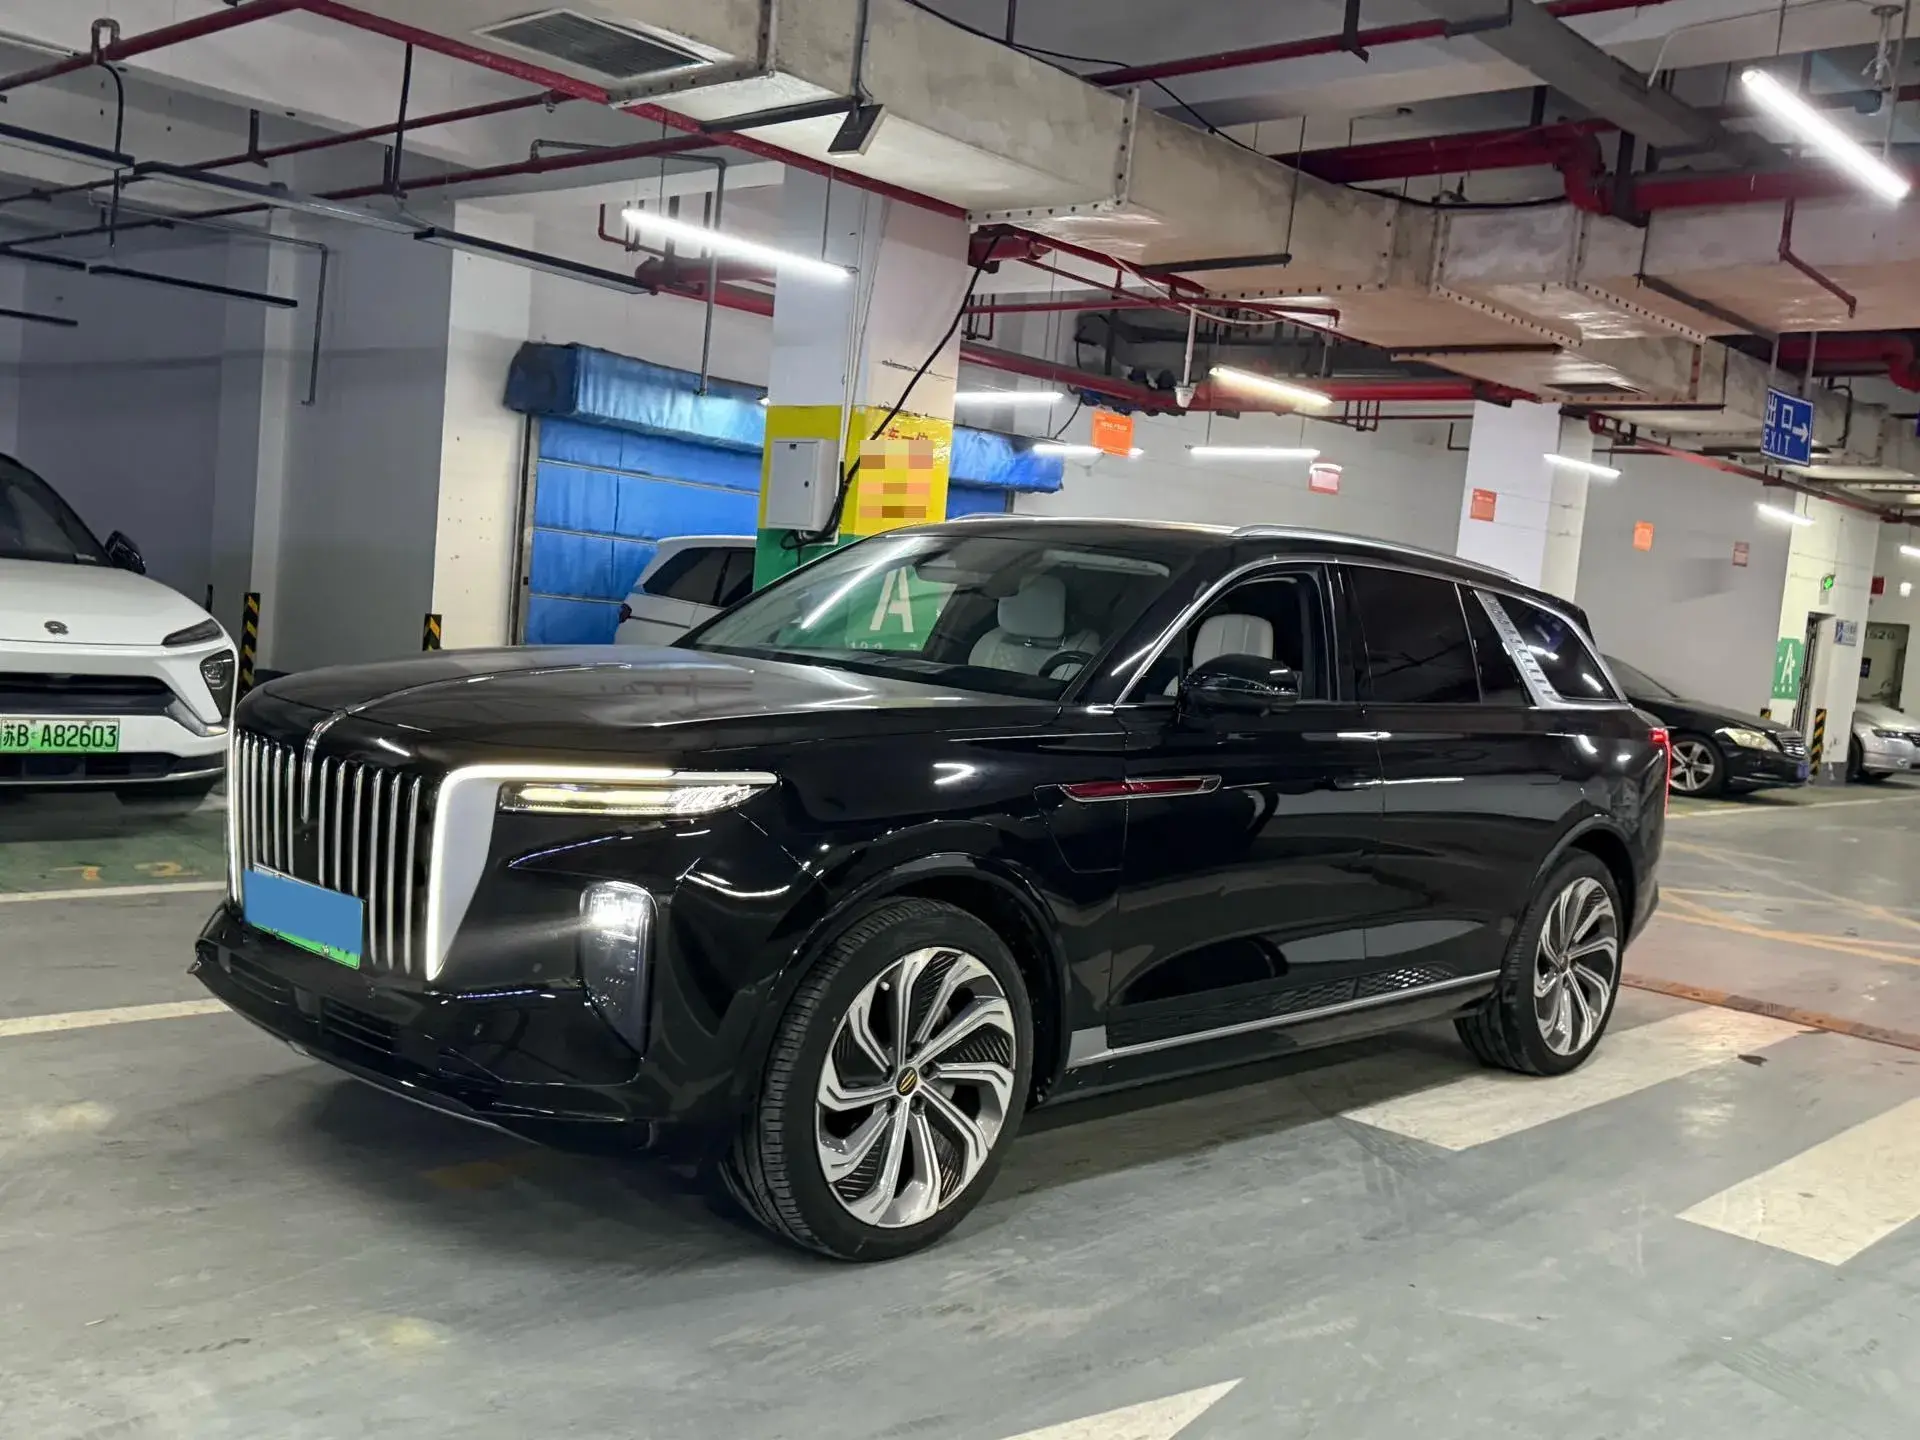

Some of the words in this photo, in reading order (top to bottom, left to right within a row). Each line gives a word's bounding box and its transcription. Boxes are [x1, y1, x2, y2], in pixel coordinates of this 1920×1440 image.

[1766, 392, 1794, 429] 出口
[1763, 428, 1791, 455] EXIT
[869, 566, 914, 633] A
[1780, 642, 1793, 685] A
